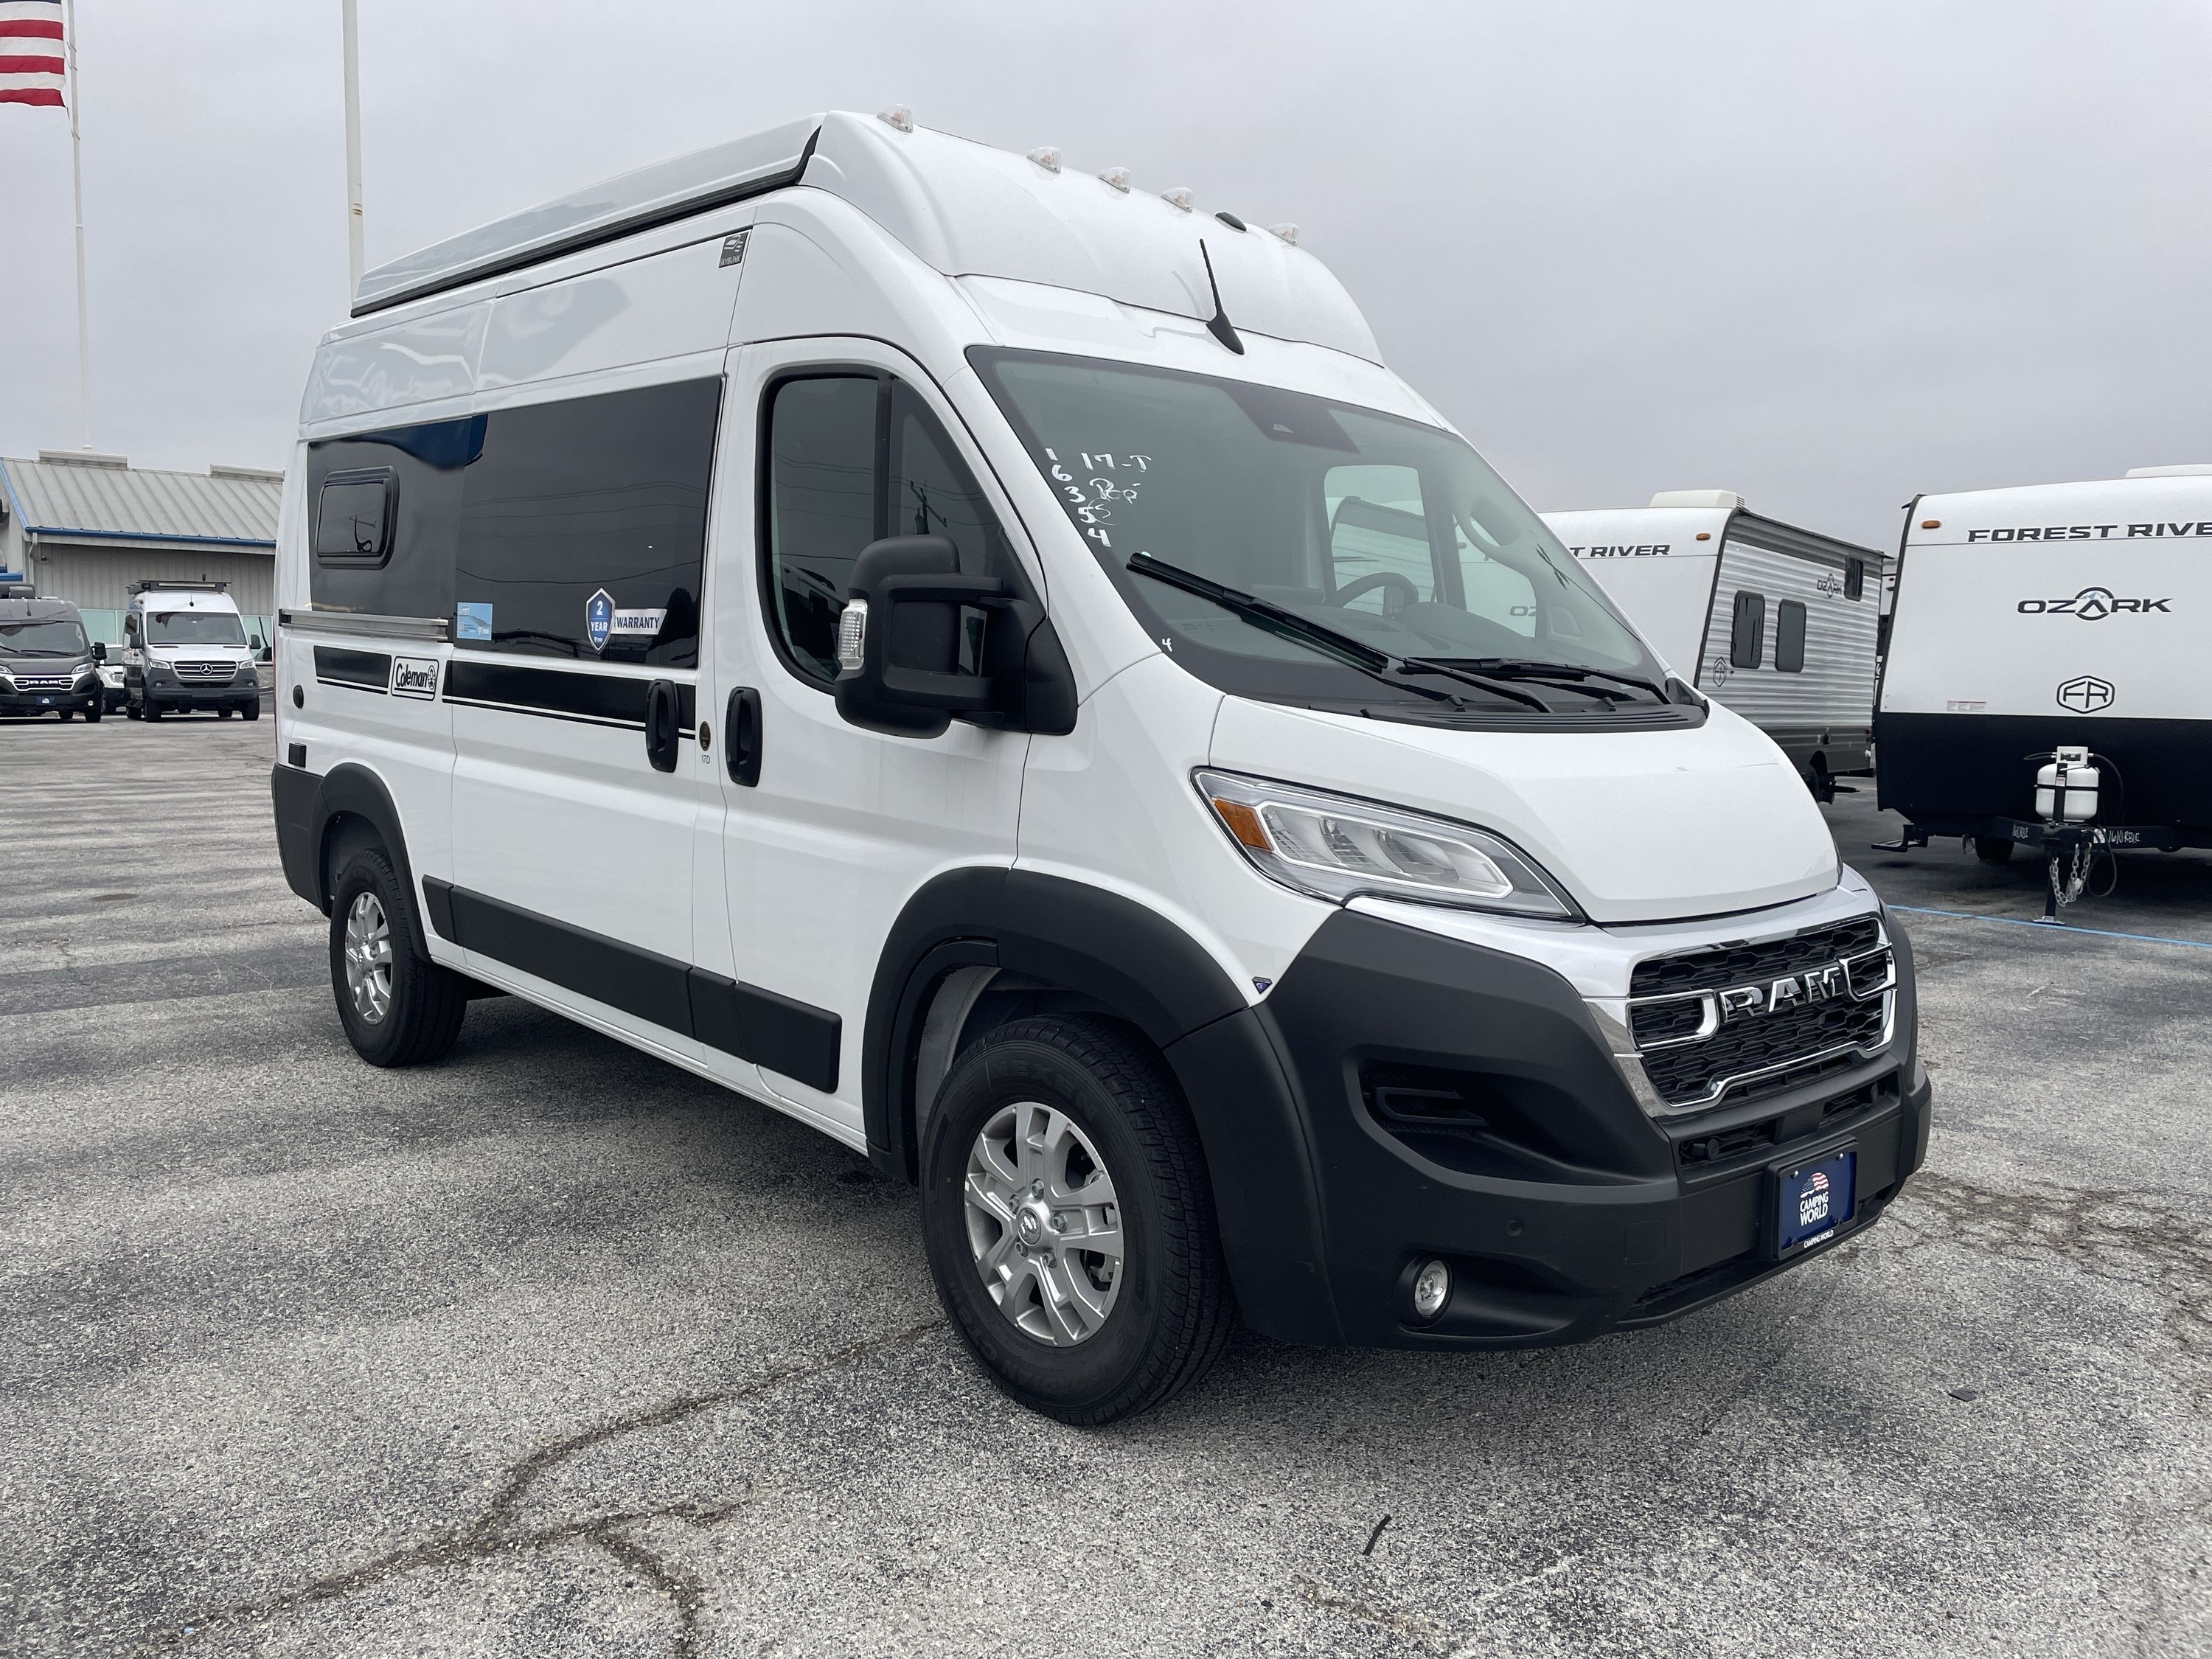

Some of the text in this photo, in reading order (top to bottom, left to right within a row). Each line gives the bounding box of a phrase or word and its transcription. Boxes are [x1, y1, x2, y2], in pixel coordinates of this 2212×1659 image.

[1967, 524, 2118, 542] FOREST
[1590, 544, 1671, 557] RIVER
[596, 600, 604, 616] 2
[2017, 597, 2174, 614] OZARK
[591, 621, 608, 632] YEAR
[616, 616, 661, 629] WARRANTY
[395, 662, 428, 688] Coleman
[1719, 966, 1843, 1023] RAM
[1800, 1191, 1829, 1213] CAMPING
[1800, 1203, 1829, 1226] WORLD
[1804, 1229, 1834, 1248] CAMPING WORLD
